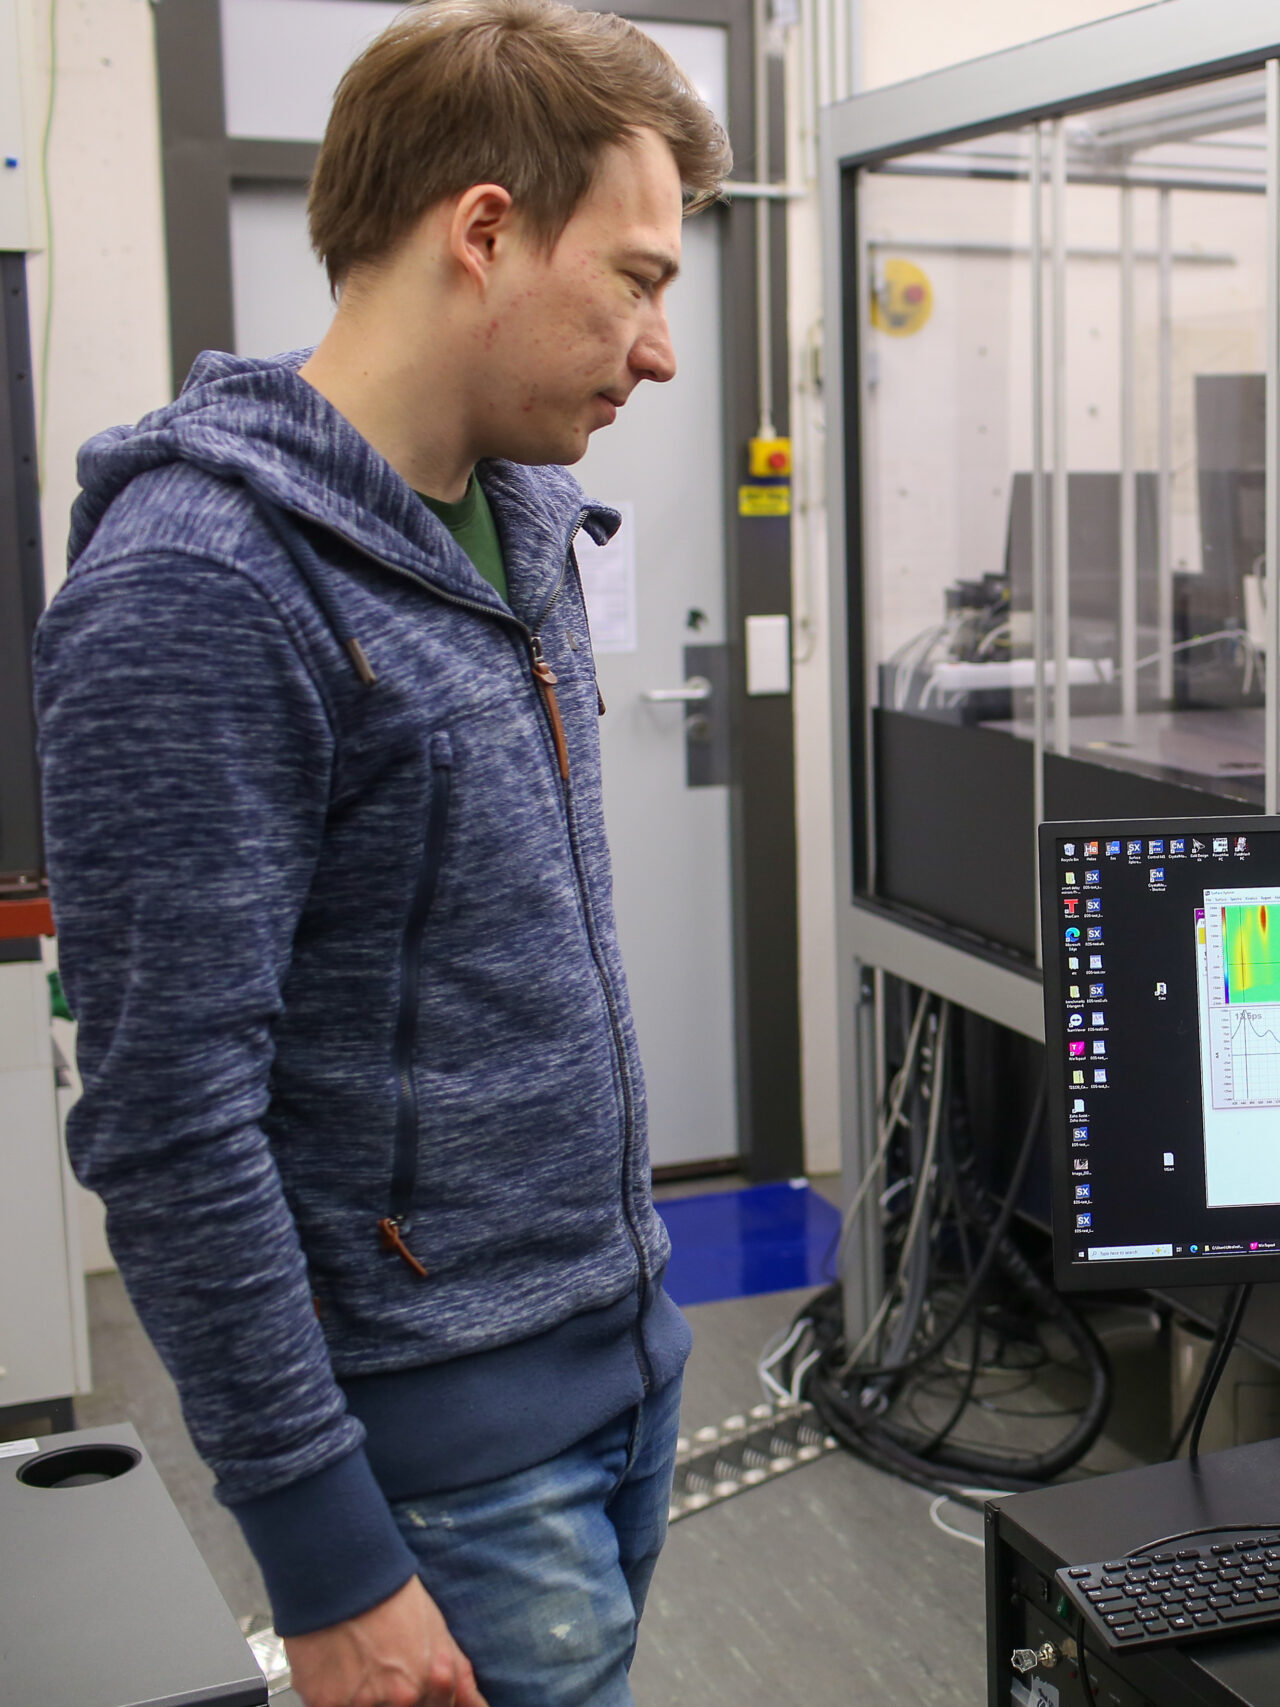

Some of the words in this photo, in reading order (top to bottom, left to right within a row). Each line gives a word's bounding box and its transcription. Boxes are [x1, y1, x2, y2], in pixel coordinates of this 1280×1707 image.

[1128, 843, 1140, 852] SX
[1086, 873, 1099, 881] SX
[1087, 901, 1100, 910] SX
[1088, 929, 1101, 938] SX
[1090, 986, 1103, 995] SX
[1074, 1130, 1087, 1139] SX
[1076, 1187, 1089, 1196] SX
[1077, 1216, 1090, 1225] SX
